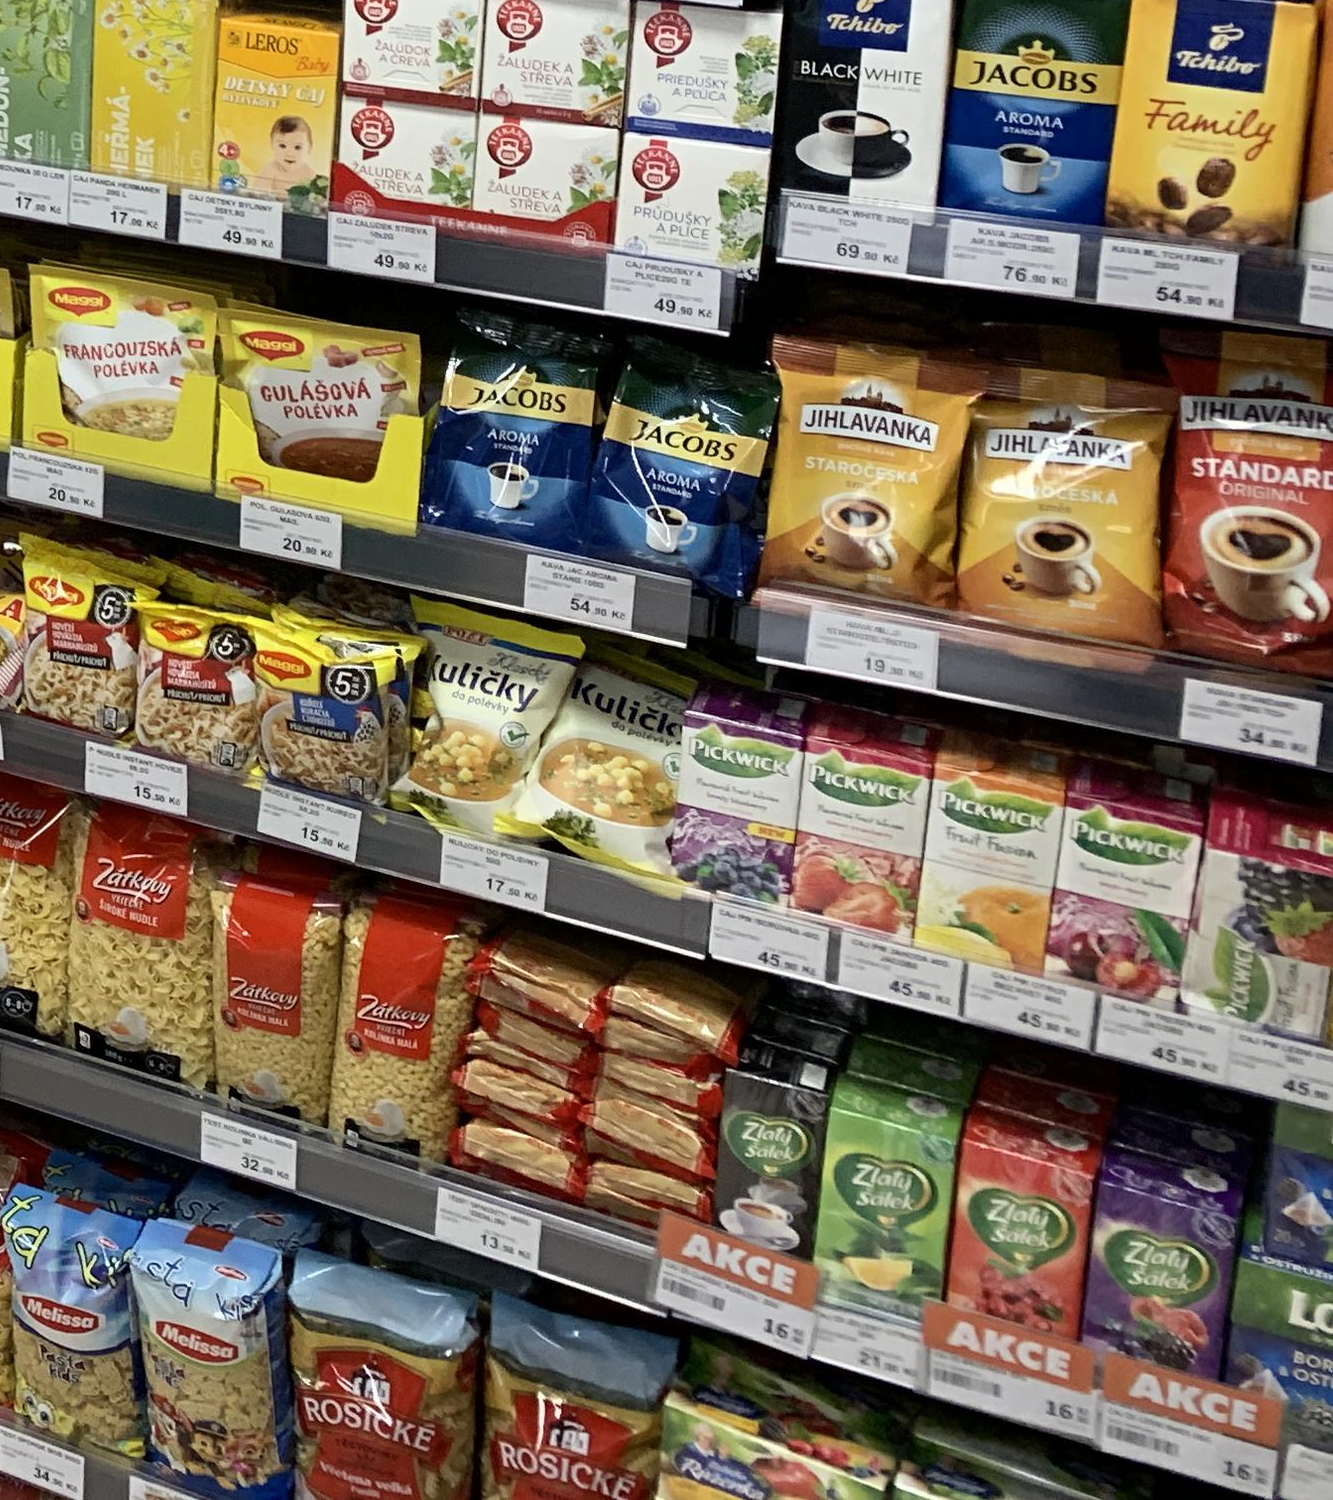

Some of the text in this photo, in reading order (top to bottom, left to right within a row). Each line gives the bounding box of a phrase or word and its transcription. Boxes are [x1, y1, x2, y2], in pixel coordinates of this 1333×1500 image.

[826, 12, 903, 37] Tchibo
[245, 32, 299, 55] LEROS
[497, 54, 574, 73] ŽALUDEK A
[801, 60, 922, 87] BLACK WHITE
[969, 60, 1099, 95] JACOBS
[1175, 51, 1262, 76] Tchibo
[520, 69, 573, 87] STŘEVA
[657, 72, 728, 89] PRIEDUŠKY
[995, 109, 1064, 130] AROMA
[1144, 98, 1278, 161] Family
[633, 202, 711, 226] PRŮDUŠKY
[53, 291, 109, 311] Maggi
[63, 337, 183, 362] FRANCOUZSKÁ
[260, 379, 371, 404] GULÁŠOVÁ
[283, 400, 359, 420] POLÉVKA
[630, 419, 738, 462] JACOBS
[804, 408, 933, 445] JIHLAVANKA
[646, 467, 701, 492] AROMA
[805, 455, 919, 484] STAROČESKÁ
[1219, 482, 1308, 505] ORIGINAL
[689, 736, 790, 778] PICKWICK
[945, 827, 1038, 860] Fruit Fusion
[1069, 817, 1186, 864] PICKWICK
[92, 857, 174, 903] Zátkovy
[357, 995, 431, 1033] Zátkovy
[851, 1162, 913, 1191] Zlatý
[681, 1232, 796, 1295] AKCE
[159, 1324, 236, 1360] Melissa
[1128, 1371, 1258, 1431] AKCE
[301, 1396, 436, 1453] ROSICKÉ
